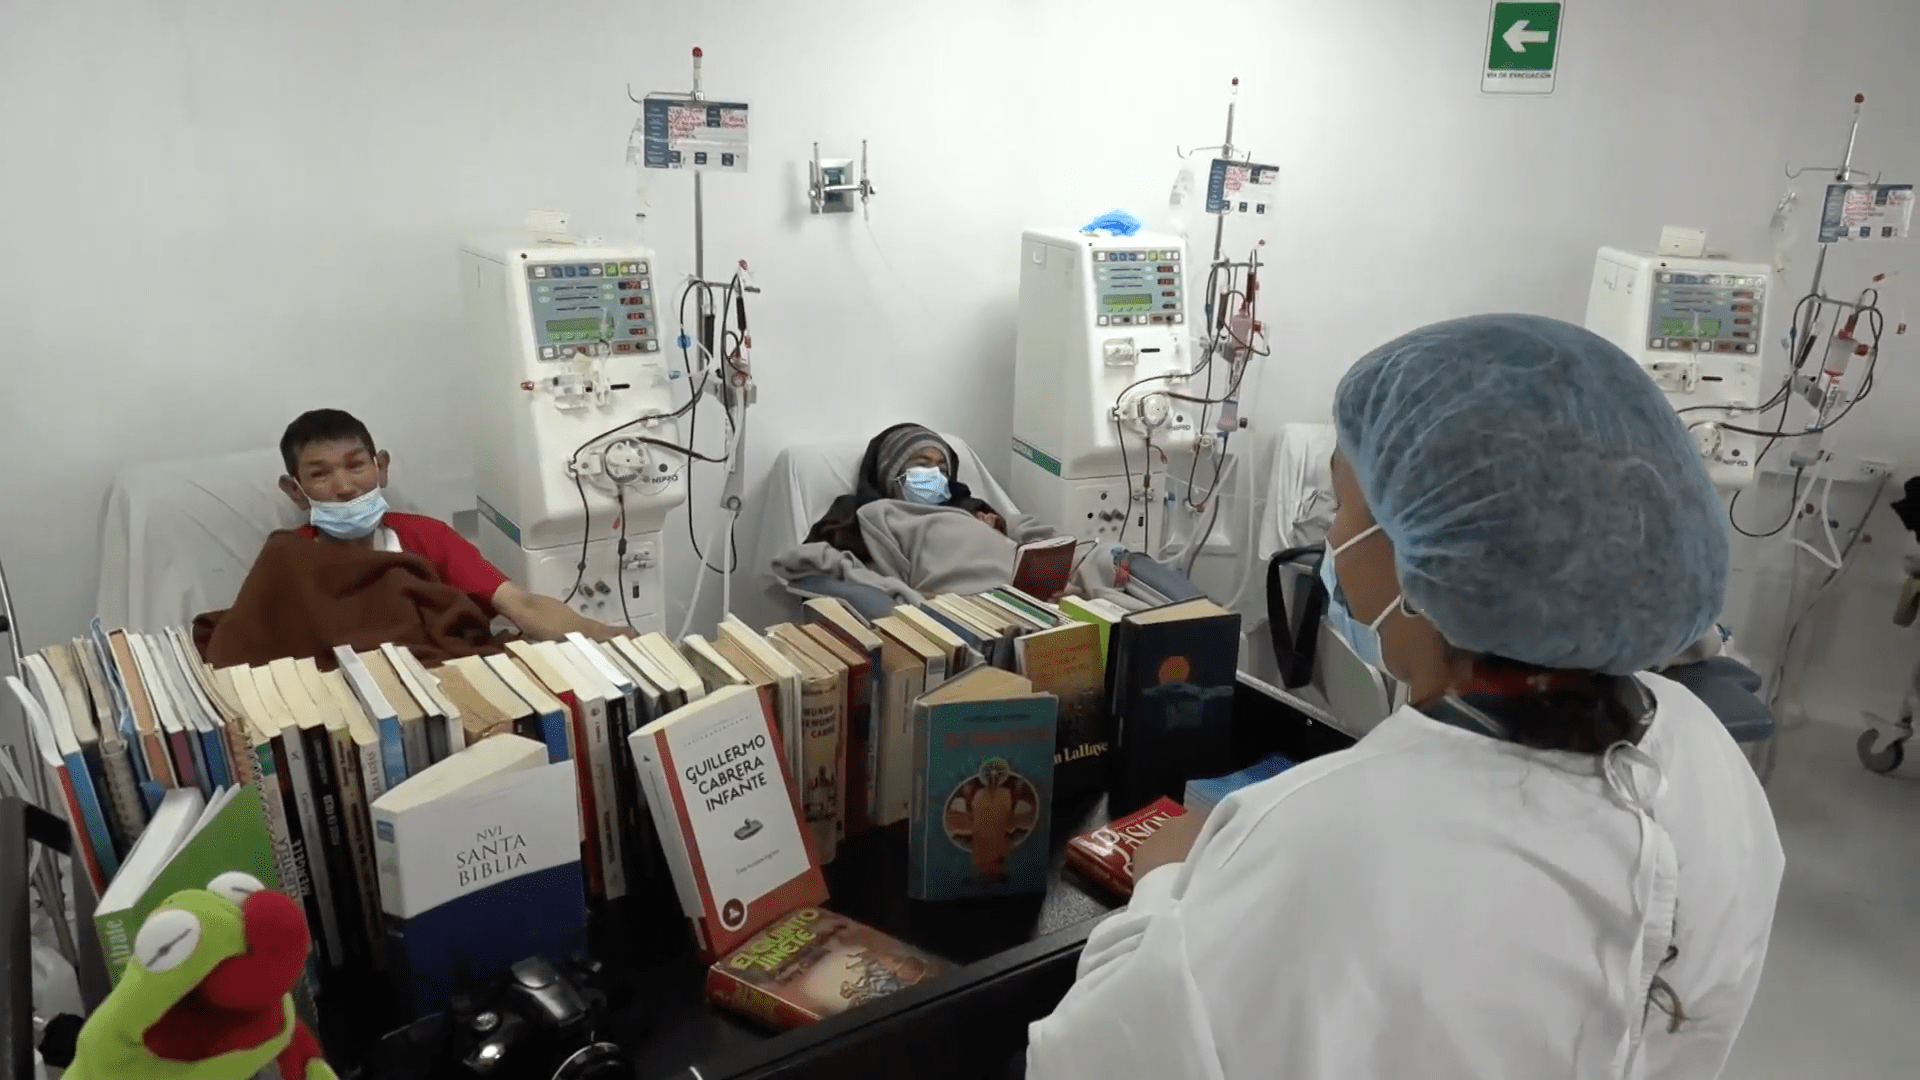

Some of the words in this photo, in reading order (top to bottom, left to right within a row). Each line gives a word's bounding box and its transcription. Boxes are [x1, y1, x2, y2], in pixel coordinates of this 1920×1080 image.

[685, 734, 766, 785] GUILLERMO
[1064, 742, 1109, 762] LaHaye
[698, 756, 765, 795] CABRERA
[705, 772, 767, 813] INFANTE
[456, 834, 527, 869] SANTA
[476, 825, 502, 843] NVI
[459, 852, 528, 887] BIBLIA
